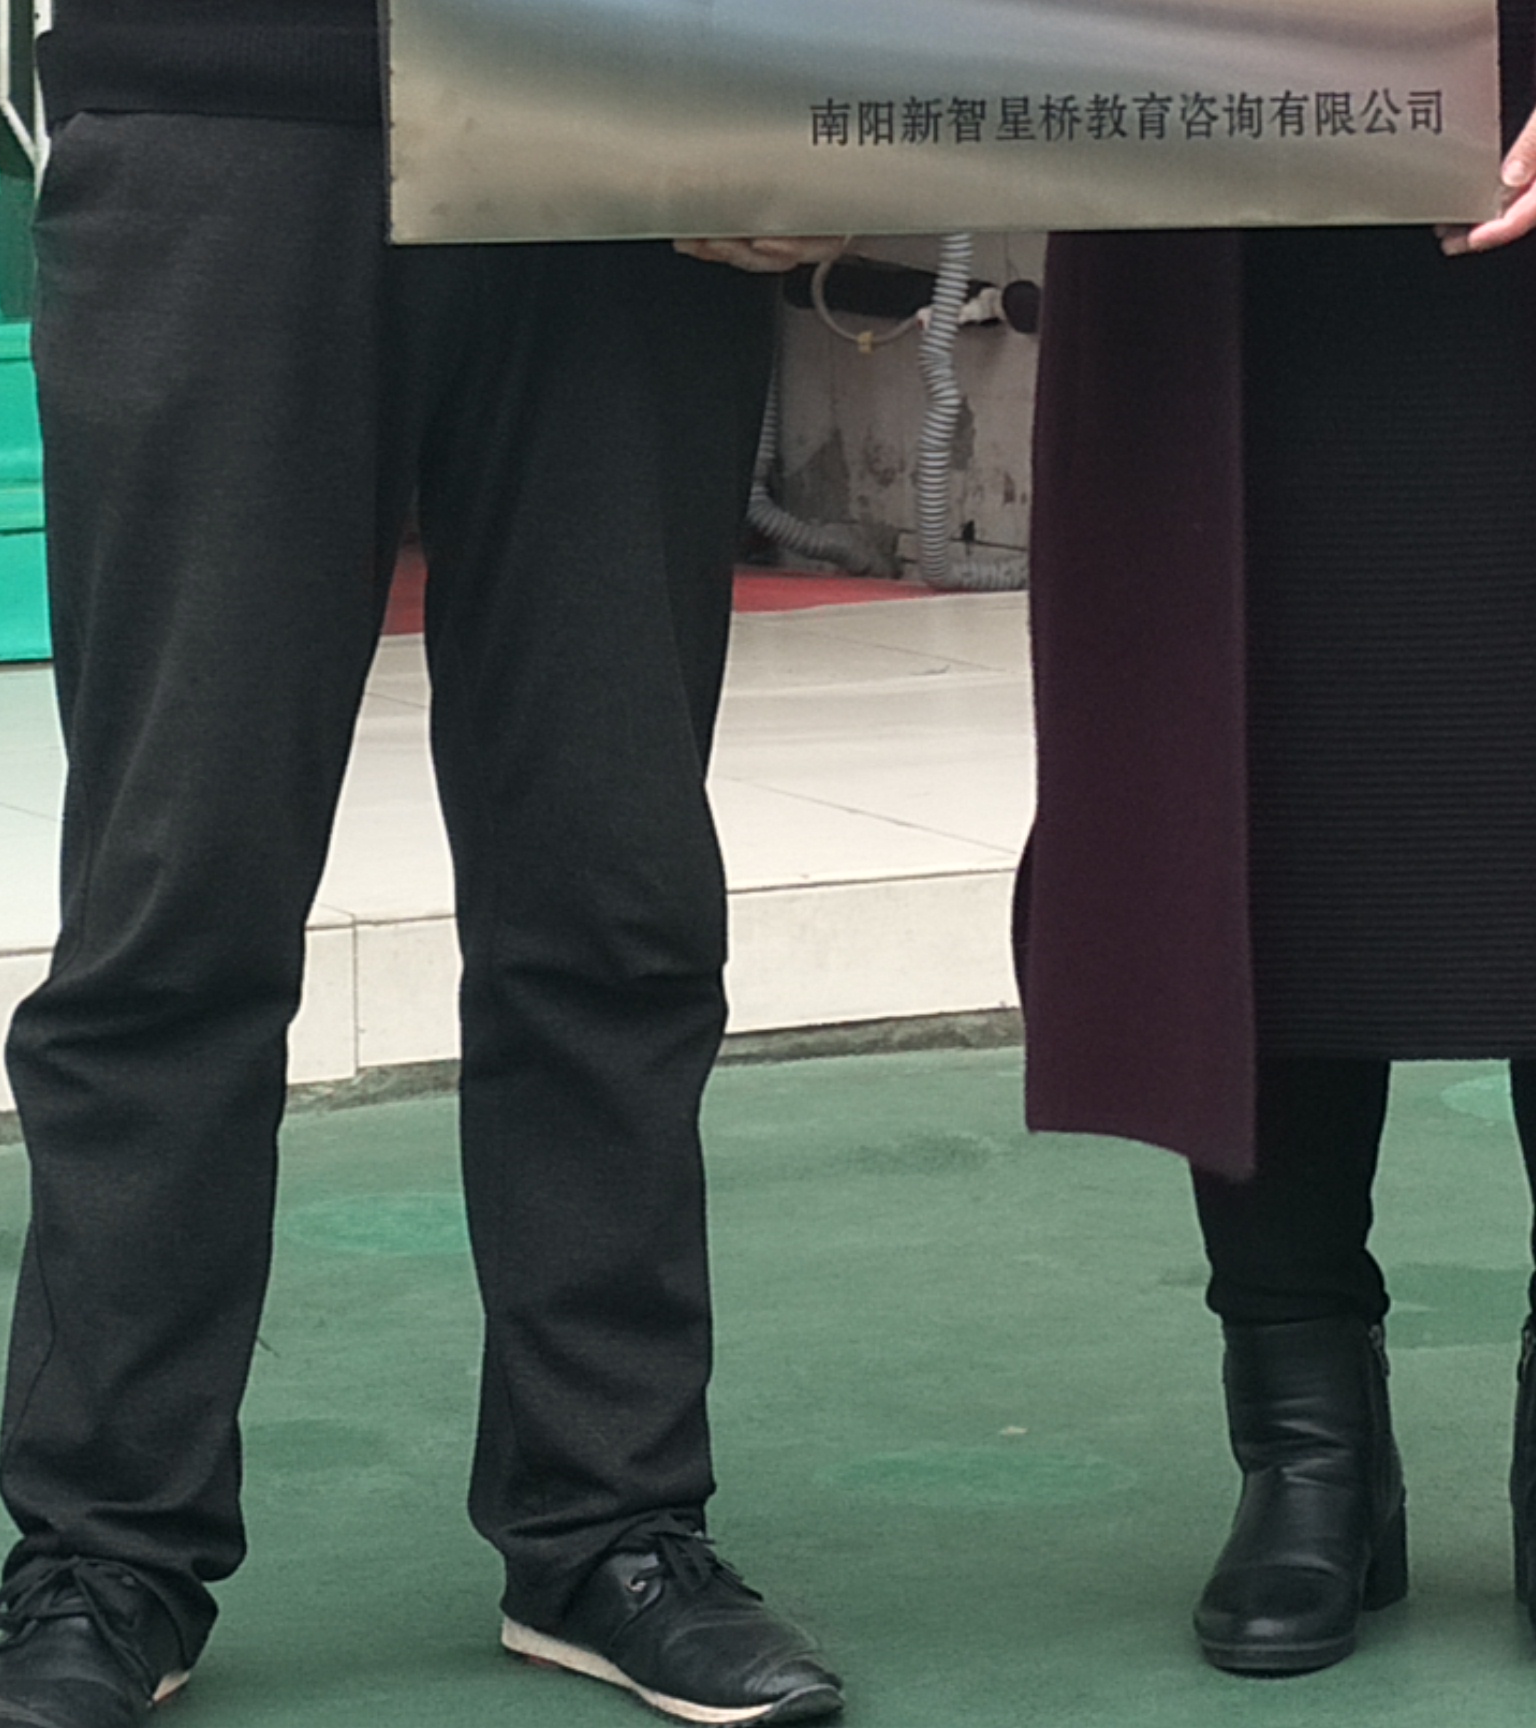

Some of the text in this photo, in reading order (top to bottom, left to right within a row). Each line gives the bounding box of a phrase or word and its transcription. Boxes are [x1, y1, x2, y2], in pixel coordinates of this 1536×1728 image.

[809, 87, 1445, 146] 南阳新智星桥教育咨询有限公司
